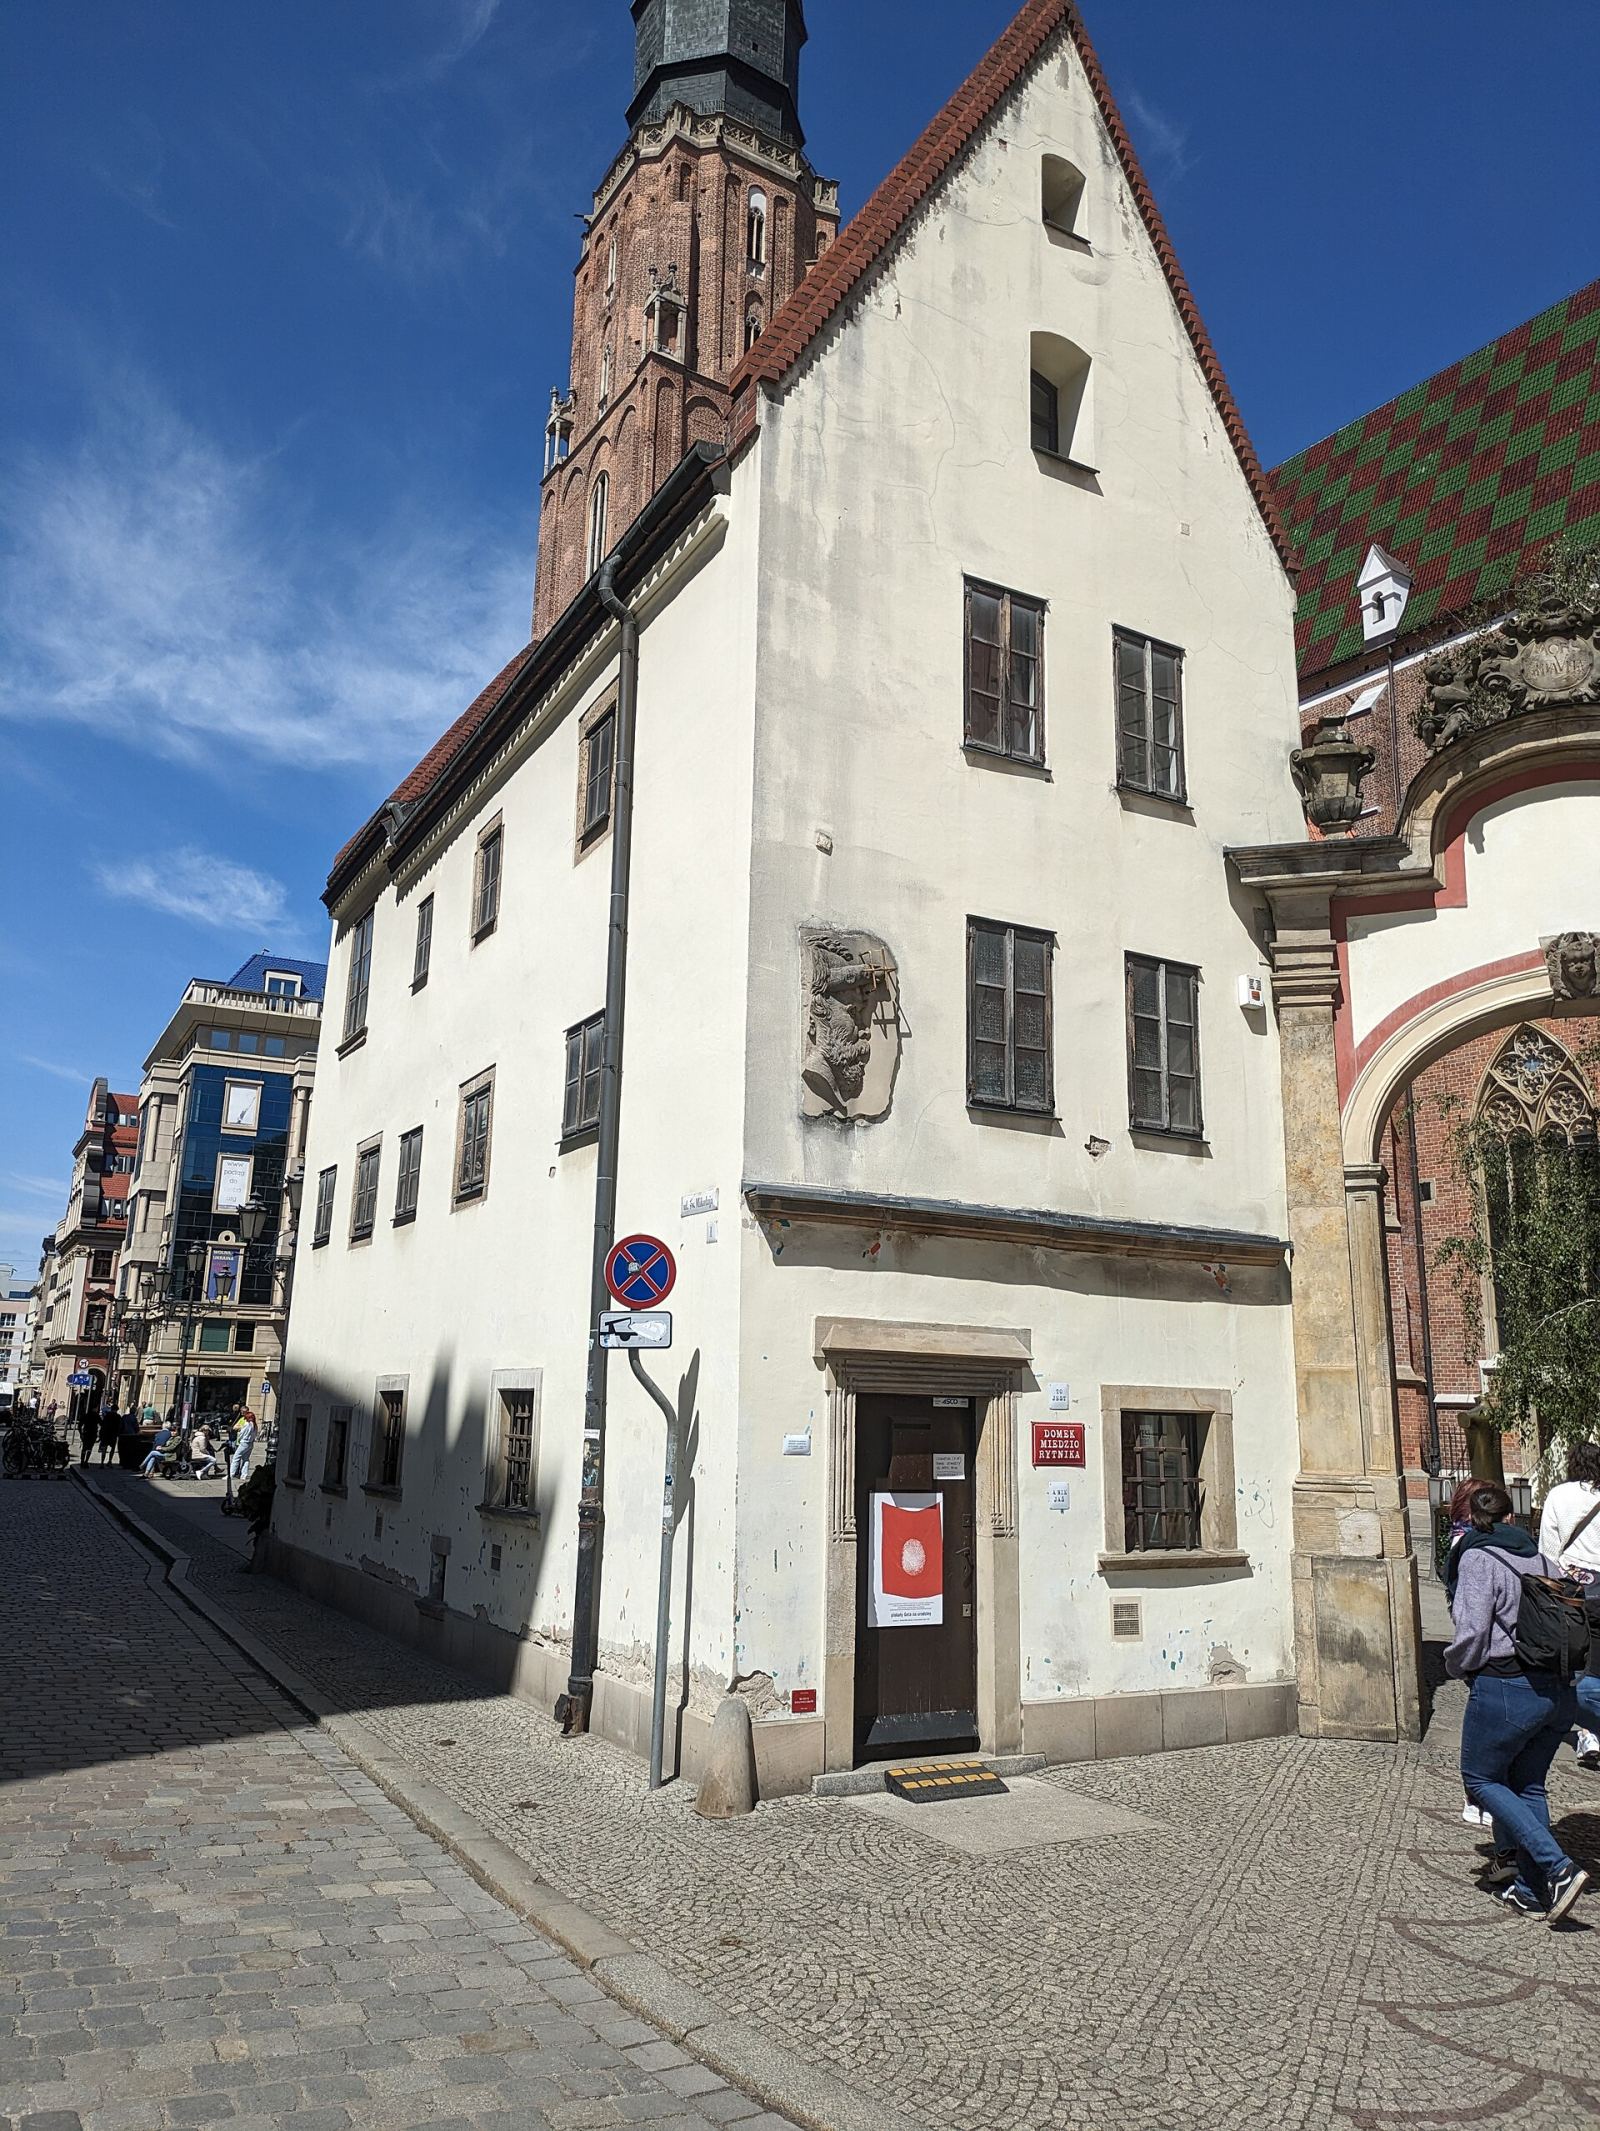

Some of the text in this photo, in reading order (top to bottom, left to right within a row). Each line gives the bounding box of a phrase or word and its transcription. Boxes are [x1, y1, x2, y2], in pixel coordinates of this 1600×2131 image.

[1044, 1429, 1075, 1439] DOMEK
[1040, 1439, 1080, 1449] MIEDZIO
[1039, 1450, 1081, 1459] RYTNIKA
